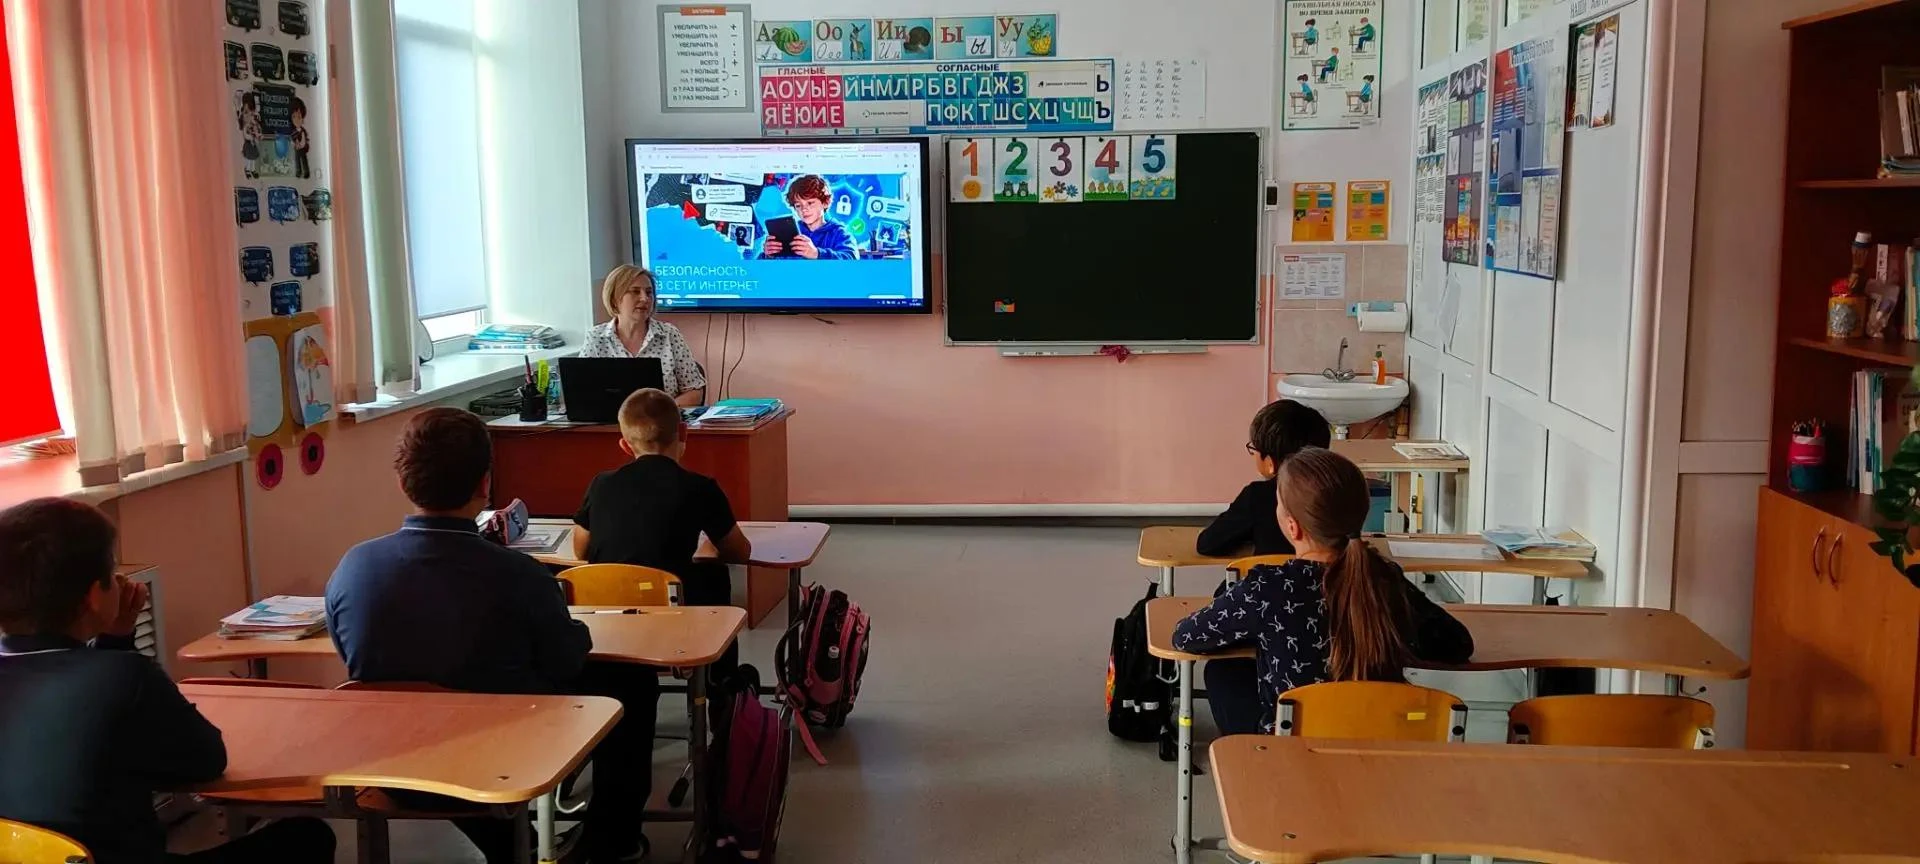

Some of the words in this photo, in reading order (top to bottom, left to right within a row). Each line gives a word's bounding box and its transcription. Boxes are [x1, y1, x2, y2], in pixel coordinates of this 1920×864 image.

[778, 67, 826, 75] ГЛАСНЫЕ
[937, 64, 1000, 72] СОГЛАСНЫЕ
[962, 142, 978, 176] 1
[1005, 141, 1028, 176] 2
[1050, 142, 1072, 177] 3
[1095, 139, 1120, 174] 4
[1143, 139, 1165, 174] 5
[656, 266, 747, 276] БЕЗОПАСНОСТЬ
[666, 280, 697, 291] СЕТИ
[700, 280, 759, 291] ИНТЕРНЕТ
